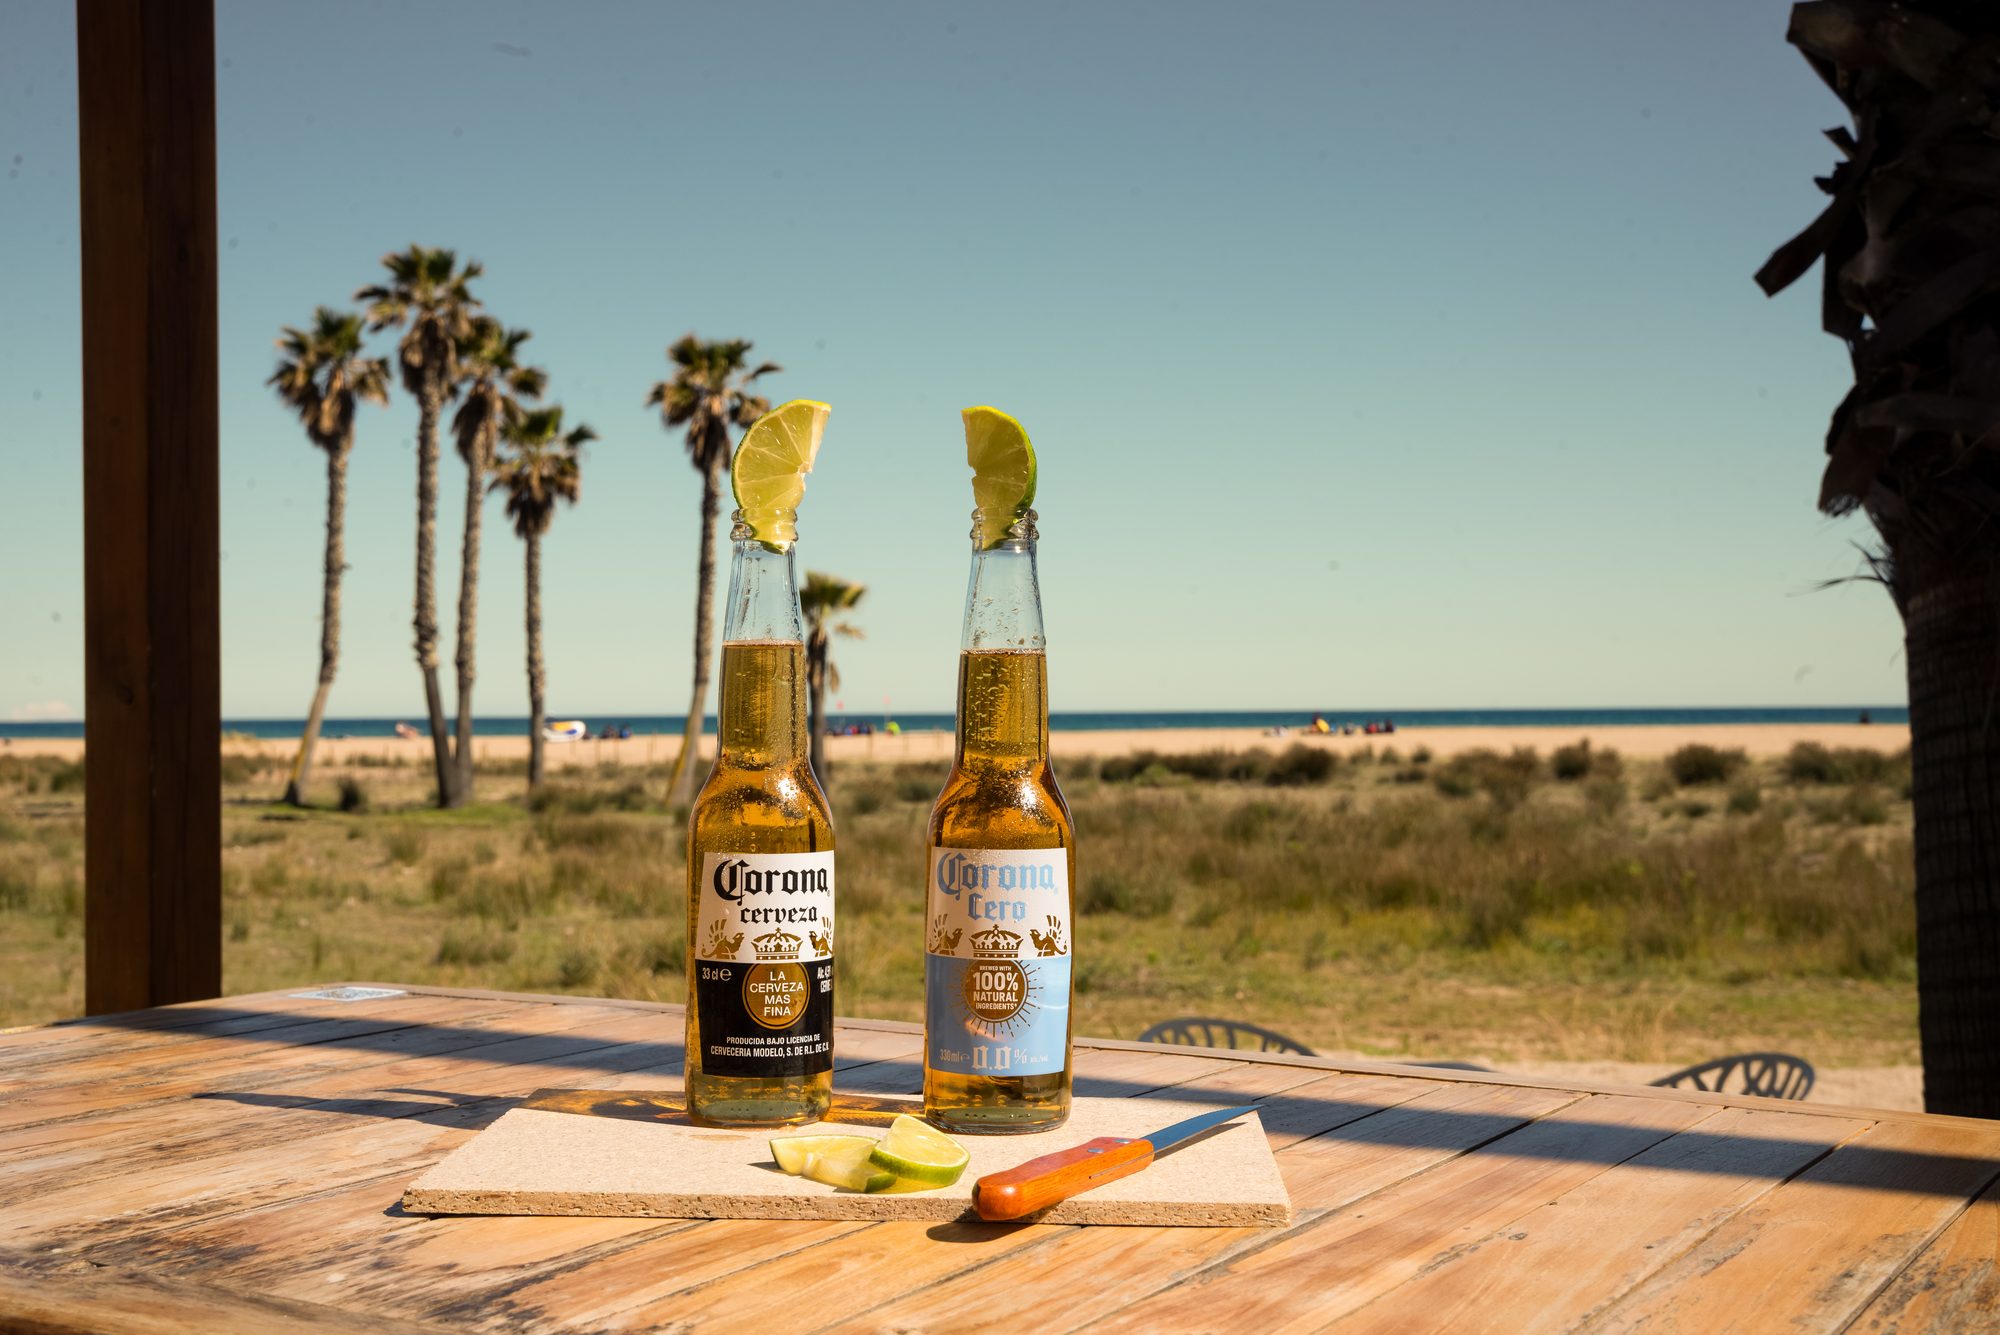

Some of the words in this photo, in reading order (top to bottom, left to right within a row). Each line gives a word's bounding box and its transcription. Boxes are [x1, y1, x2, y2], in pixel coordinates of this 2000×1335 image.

[713, 859, 828, 906] Corona
[937, 852, 1055, 901] Corona
[968, 892, 1027, 922] Cero
[740, 906, 818, 924] cerveza
[702, 967, 710, 980] 33
[769, 971, 786, 981] LA
[749, 982, 805, 993] CERVEZA
[972, 971, 1019, 991] 100%
[764, 994, 791, 1005] MAS
[973, 991, 1019, 1002] NATURAL
[764, 1006, 791, 1017] FINA
[726, 1036, 765, 1045] PRODUCIDA
[766, 1036, 785, 1045] BAJO
[786, 1034, 813, 1044] LICENCIA
[813, 1033, 821, 1042] DE
[710, 1045, 752, 1057] CERVECERIA
[753, 1047, 785, 1058] MODELO,
[786, 1047, 794, 1057] S.
[794, 1046, 804, 1056] DE
